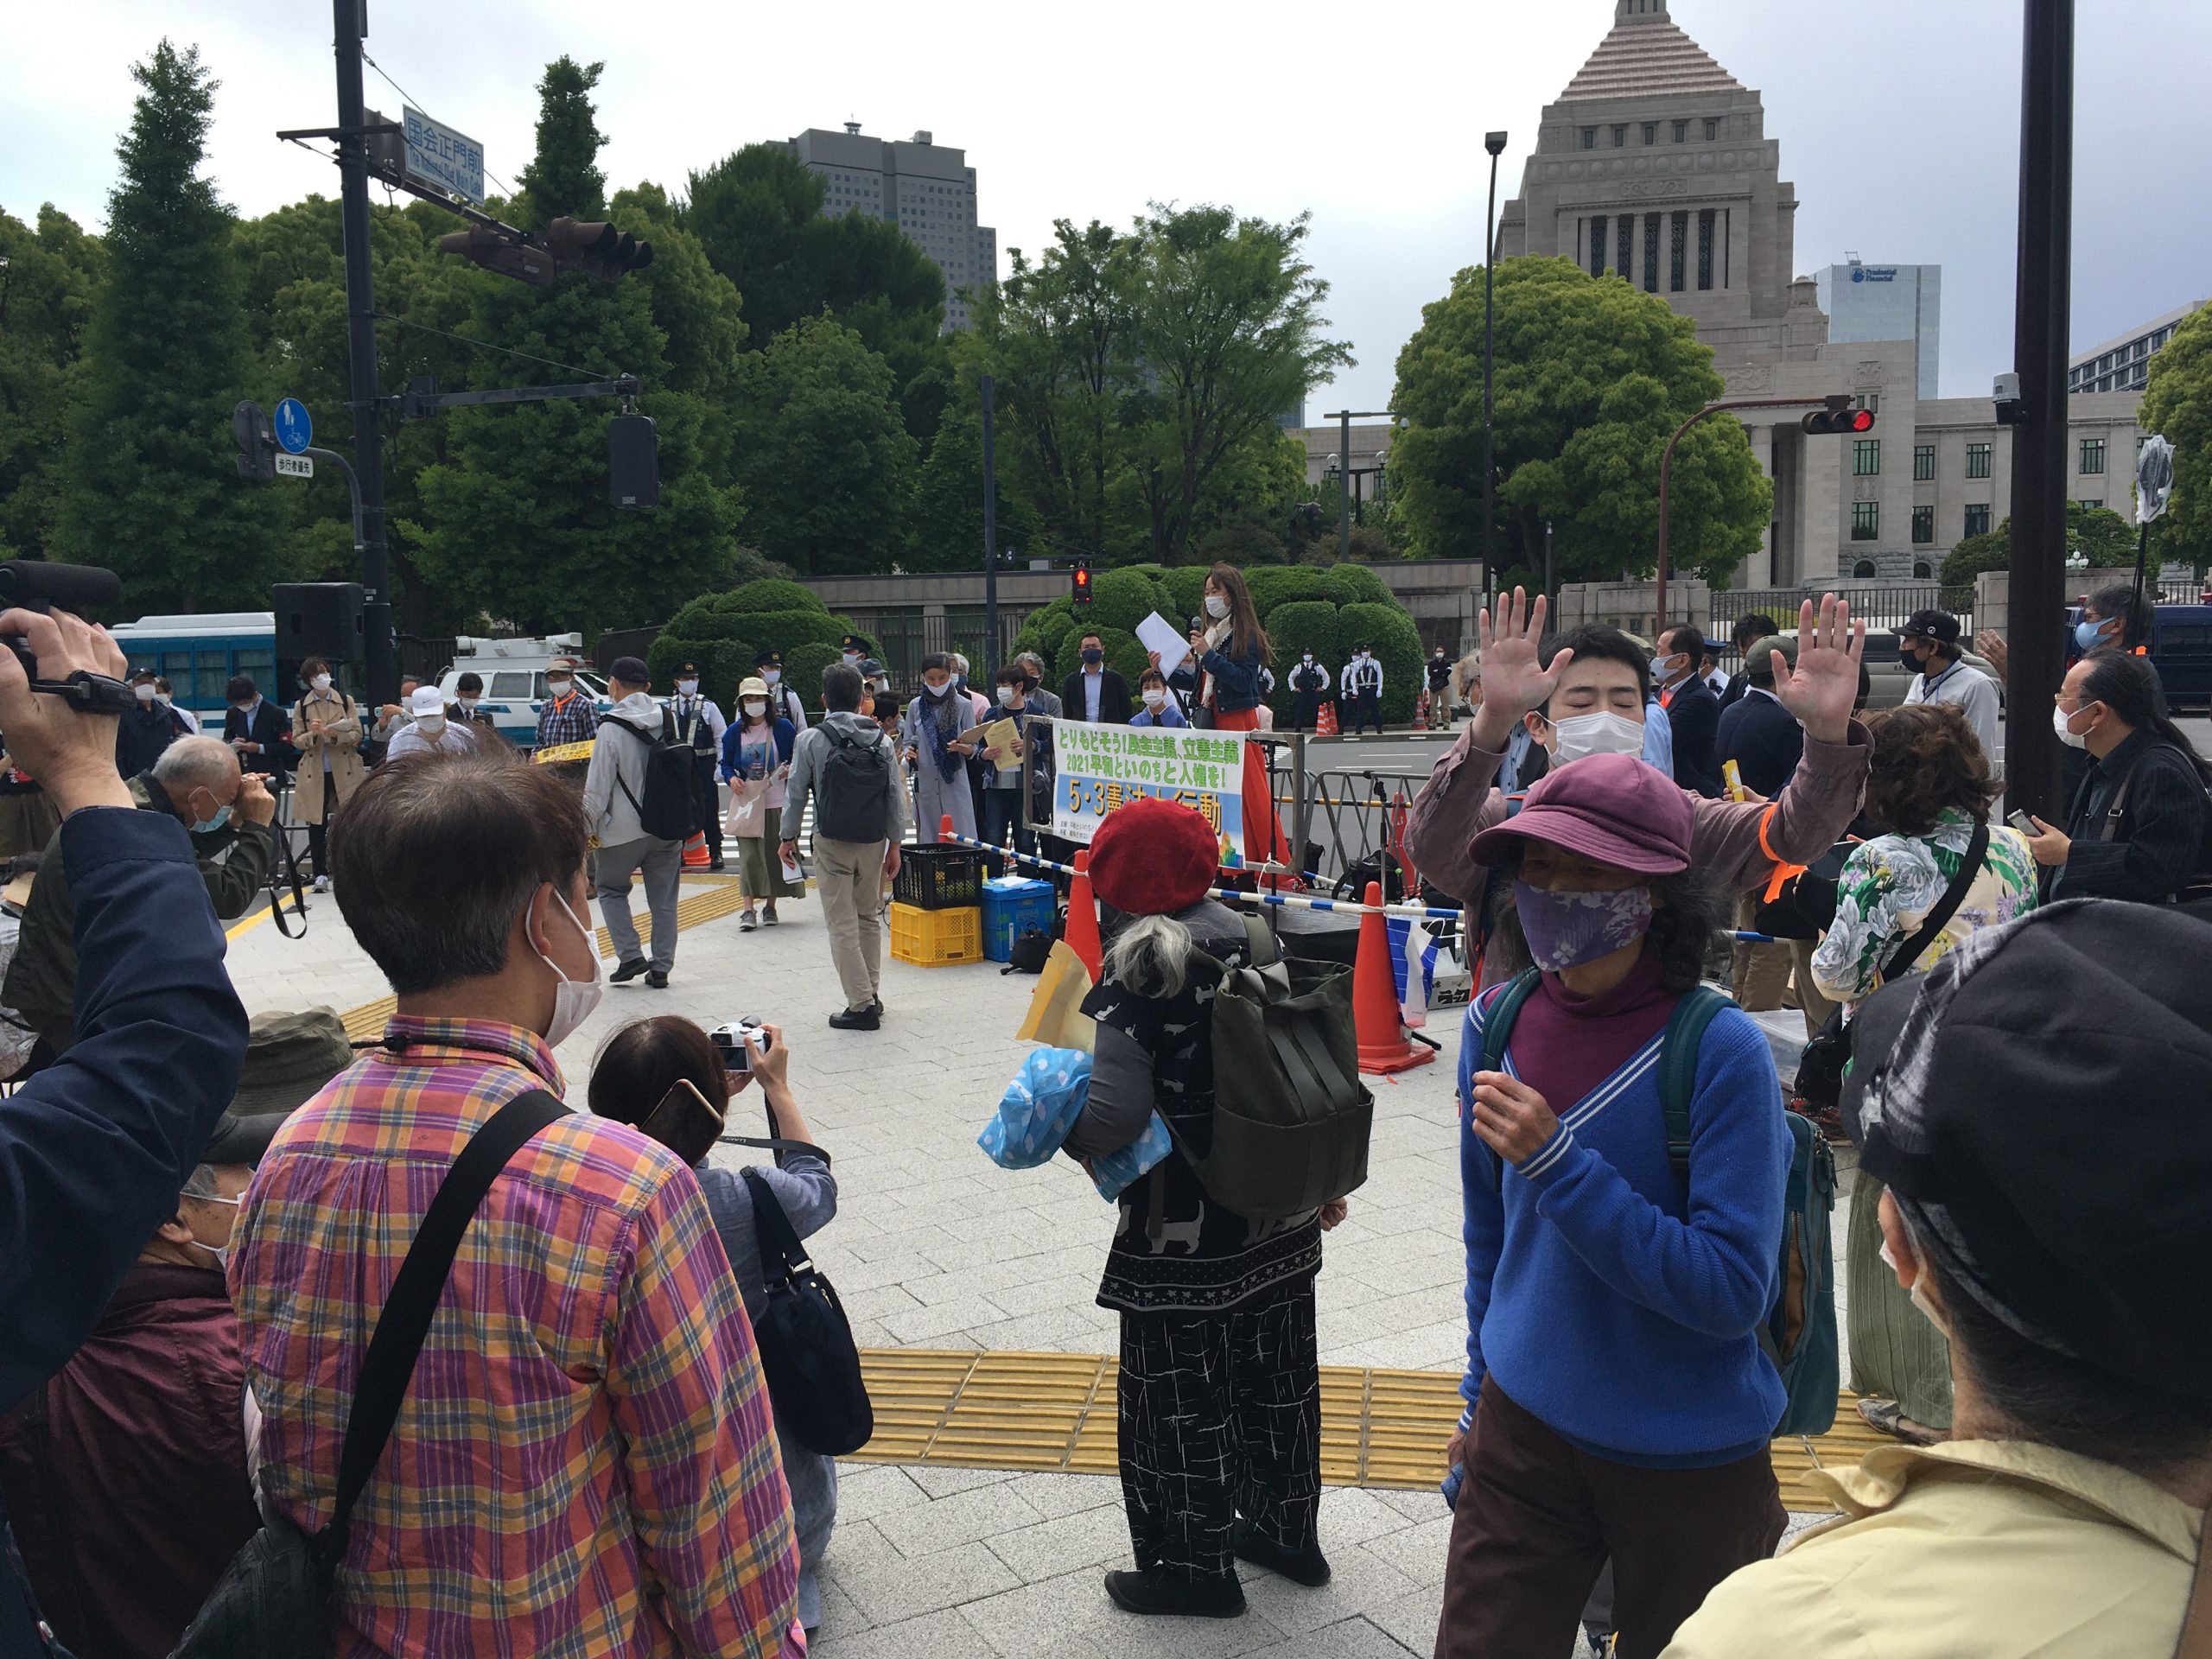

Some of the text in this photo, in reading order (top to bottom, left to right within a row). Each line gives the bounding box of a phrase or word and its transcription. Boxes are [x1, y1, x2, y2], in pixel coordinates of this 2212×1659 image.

[408, 117, 481, 176] 国会正門前
[408, 146, 420, 168] The
[422, 153, 444, 179] National
[456, 168, 469, 190] Main
[469, 175, 481, 197] Gate
[278, 458, 310, 474] 歩行者優先
